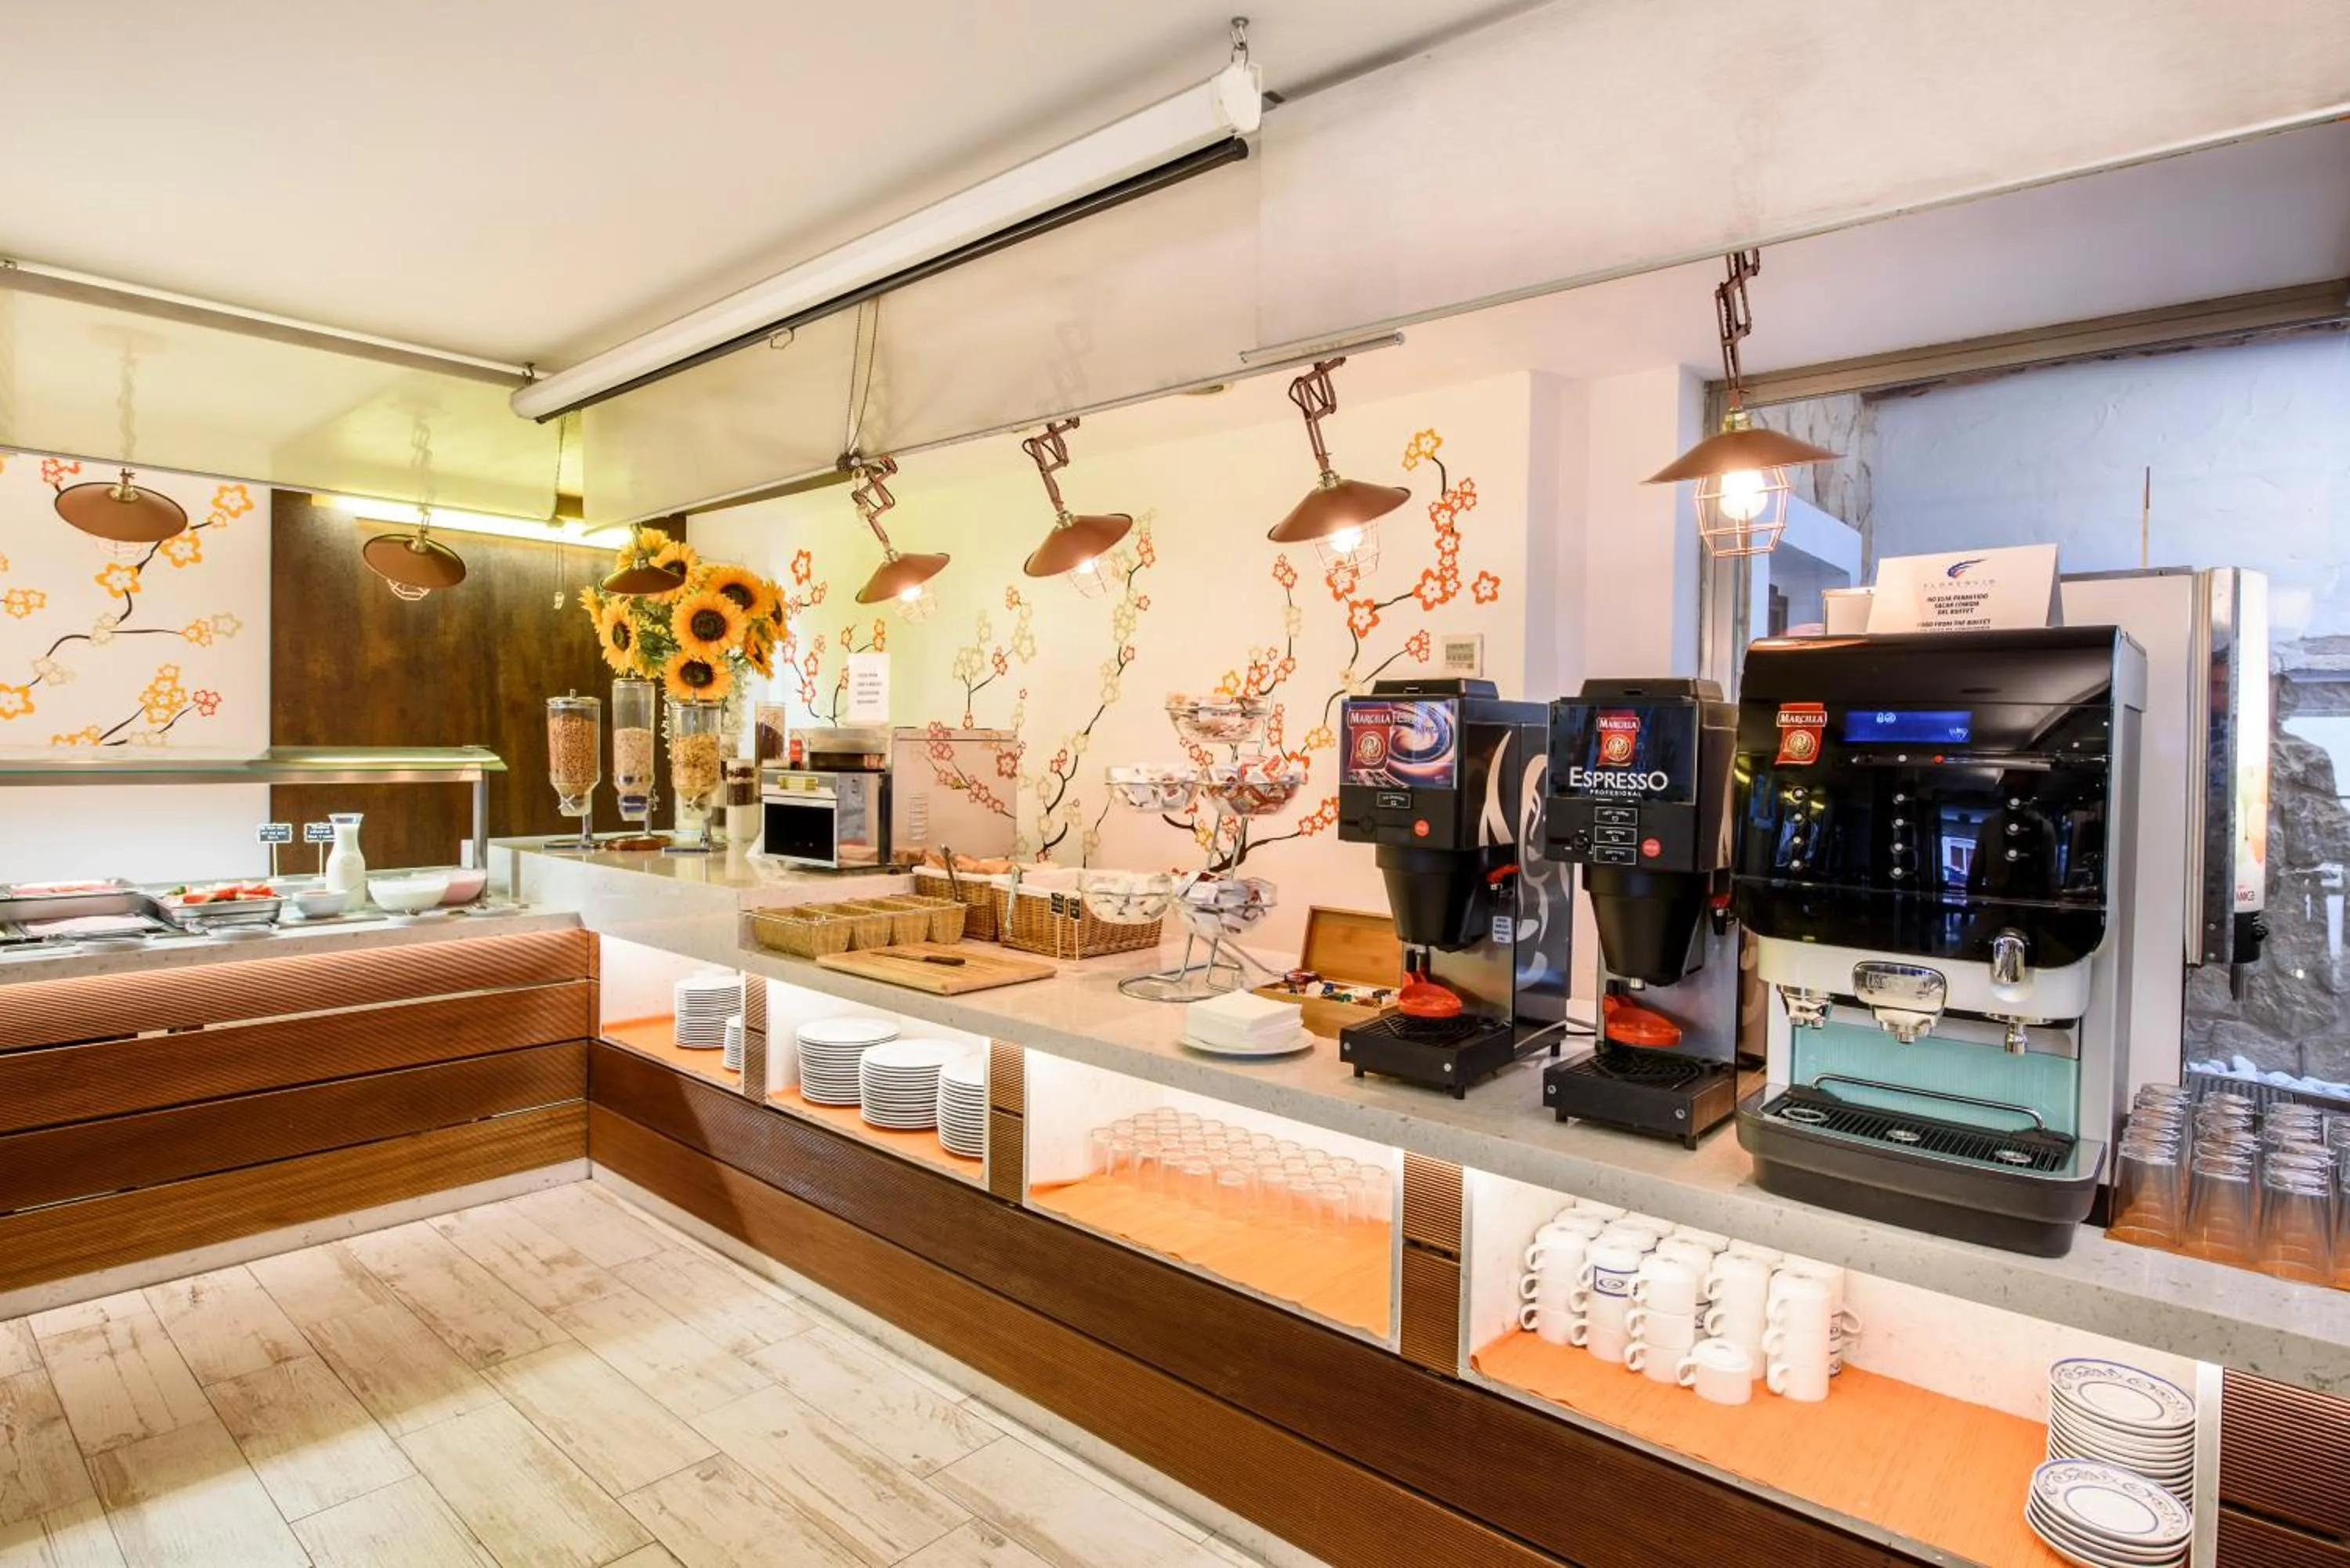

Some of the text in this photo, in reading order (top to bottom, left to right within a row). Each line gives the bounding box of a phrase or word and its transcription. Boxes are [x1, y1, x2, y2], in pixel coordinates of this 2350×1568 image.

[1350, 712, 1391, 724] MARCILLA
[1600, 718, 1638, 729] MARCILLA
[1780, 714, 1824, 724] MARCILLA
[1569, 767, 1669, 792] ESPRESSO
[1589, 789, 1643, 797] PROFESIONAL
